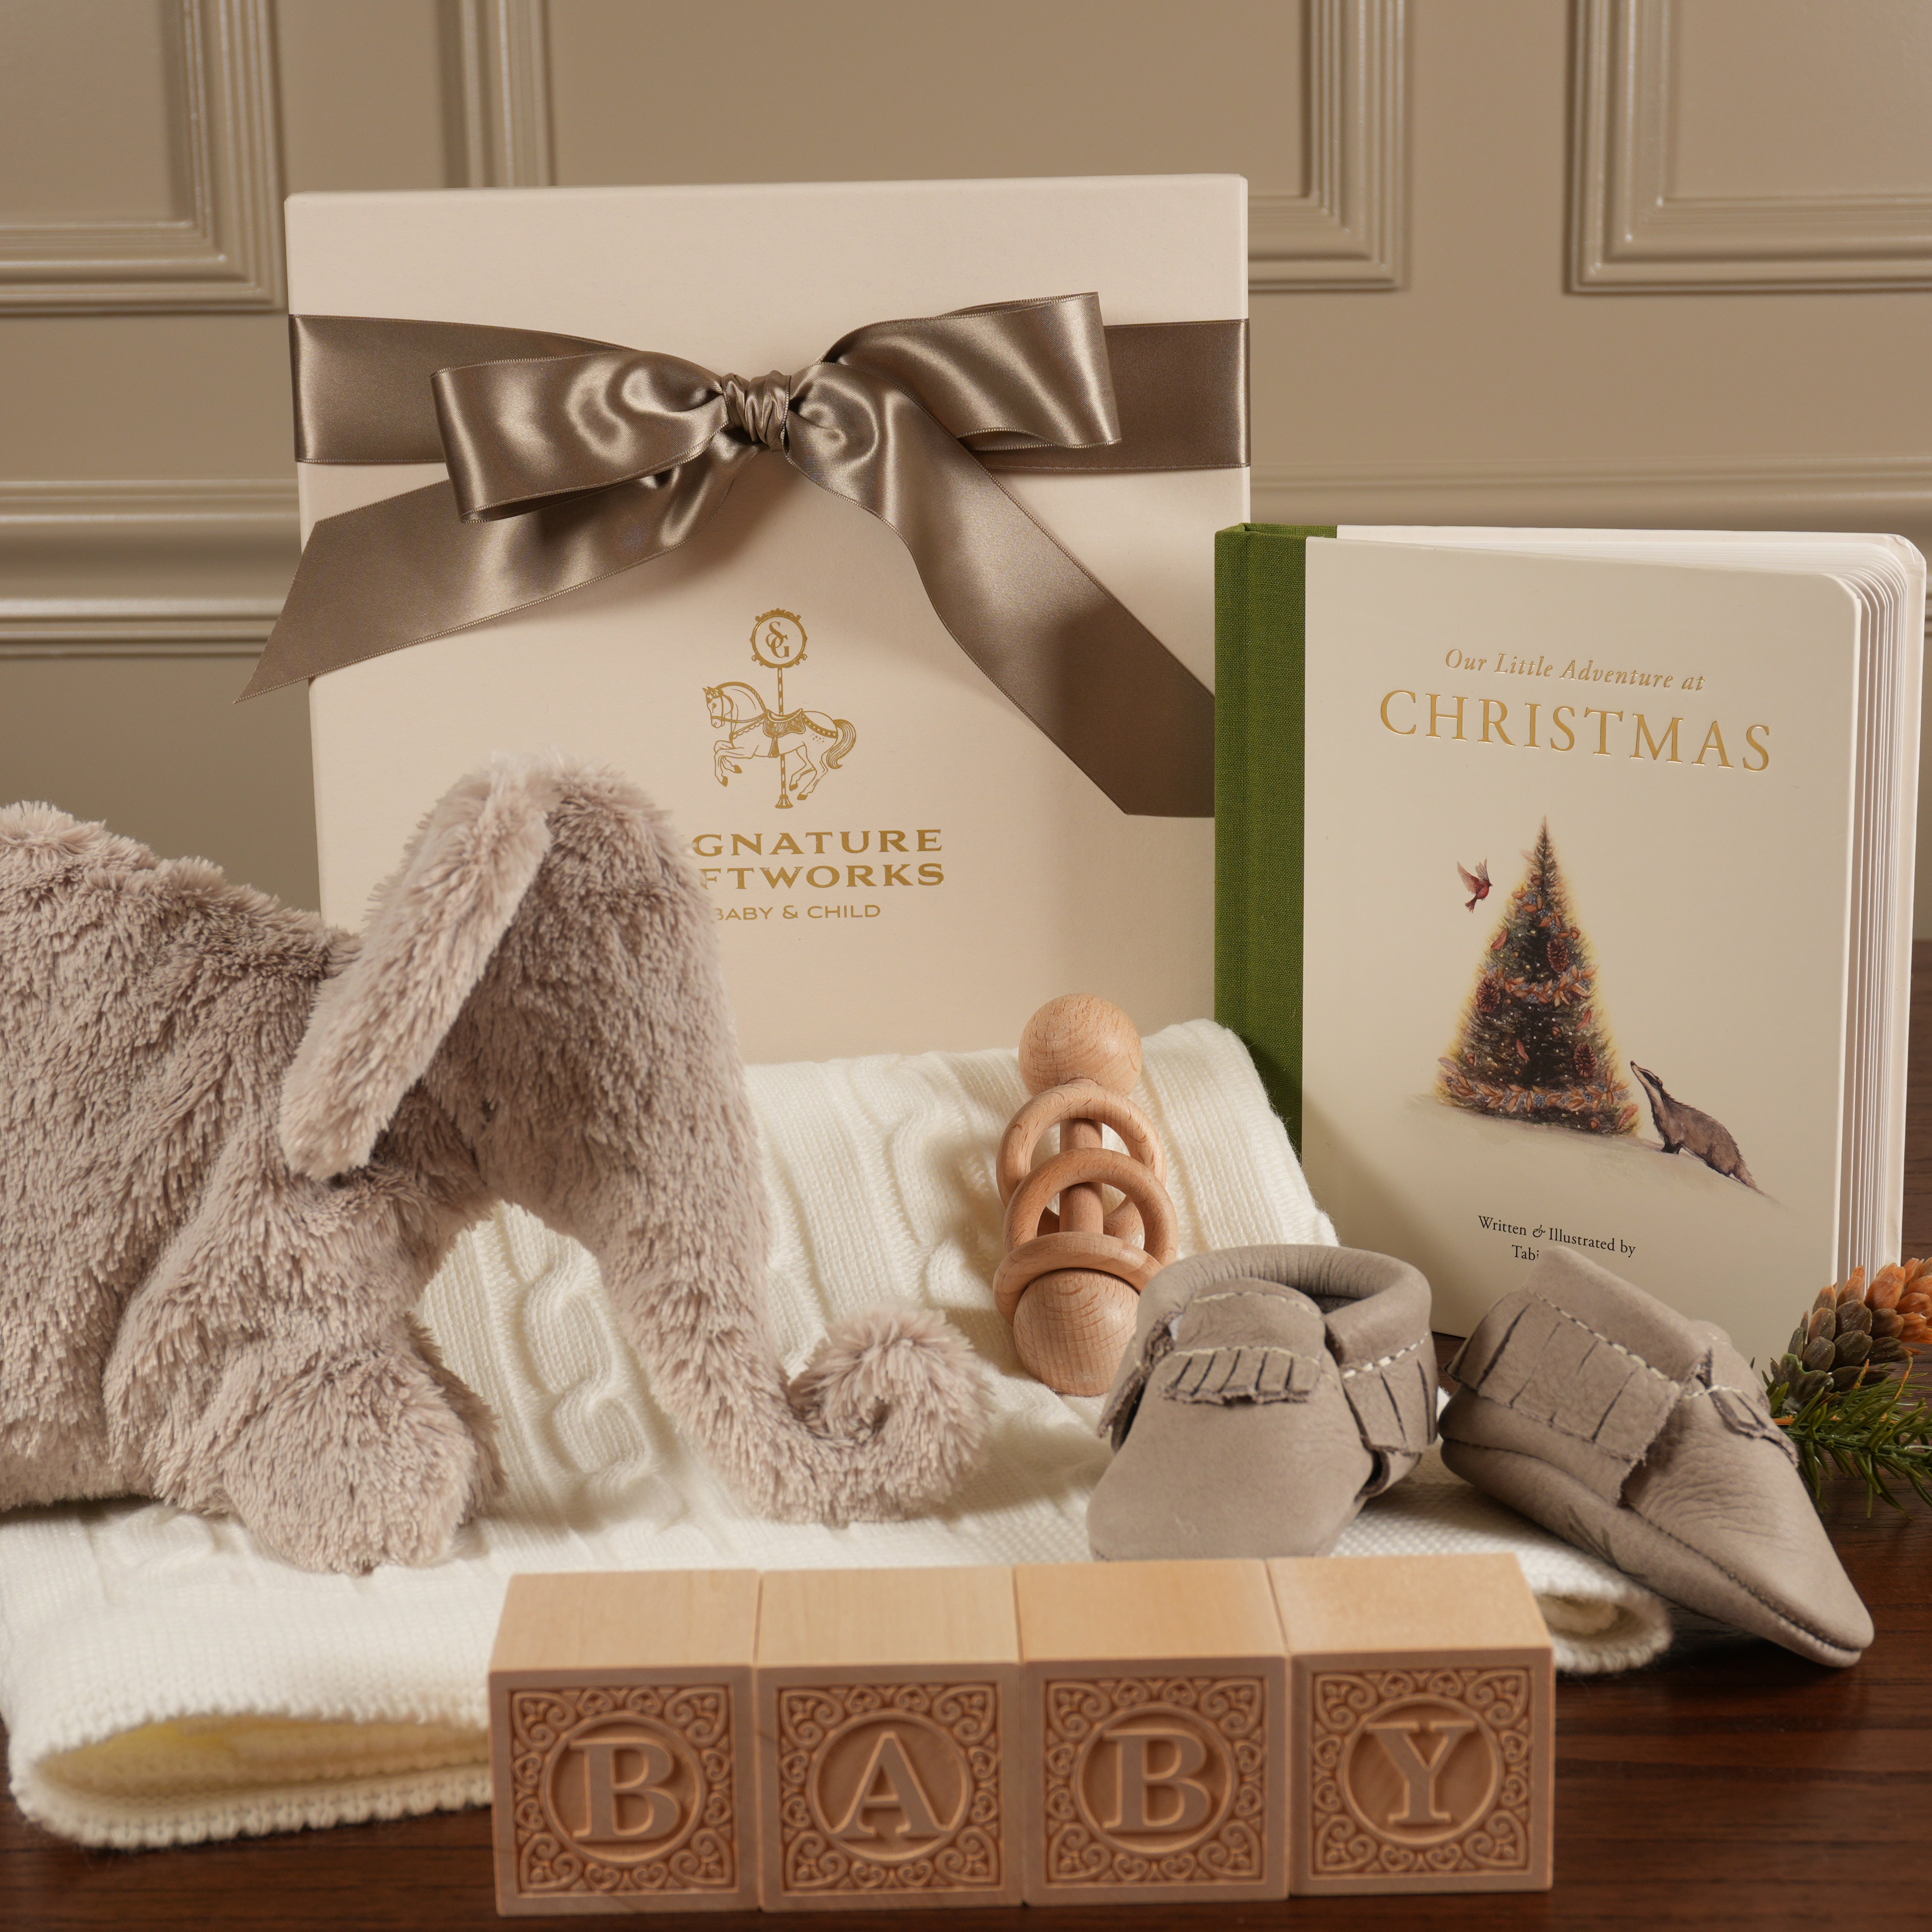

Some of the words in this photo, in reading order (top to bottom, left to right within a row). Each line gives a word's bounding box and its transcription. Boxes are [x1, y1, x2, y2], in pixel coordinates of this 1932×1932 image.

[1445, 649, 1487, 671] Our
[1494, 653, 1553, 677] Little
[1559, 659, 1674, 689] Adventure
[1681, 675, 1705, 692] at
[1380, 689, 1771, 773] CHRISTMAS
[692, 828, 943, 857] GNATURE
[698, 862, 945, 890] FTWORKS
[782, 904, 798, 919] &
[807, 904, 882, 919] CHILD
[1478, 1215, 1527, 1236] Written
[1532, 1224, 1546, 1238] &
[1549, 1227, 1616, 1251] Illustrated
[1620, 1239, 1636, 1258] by
[1511, 1244, 1539, 1261] Tabi
